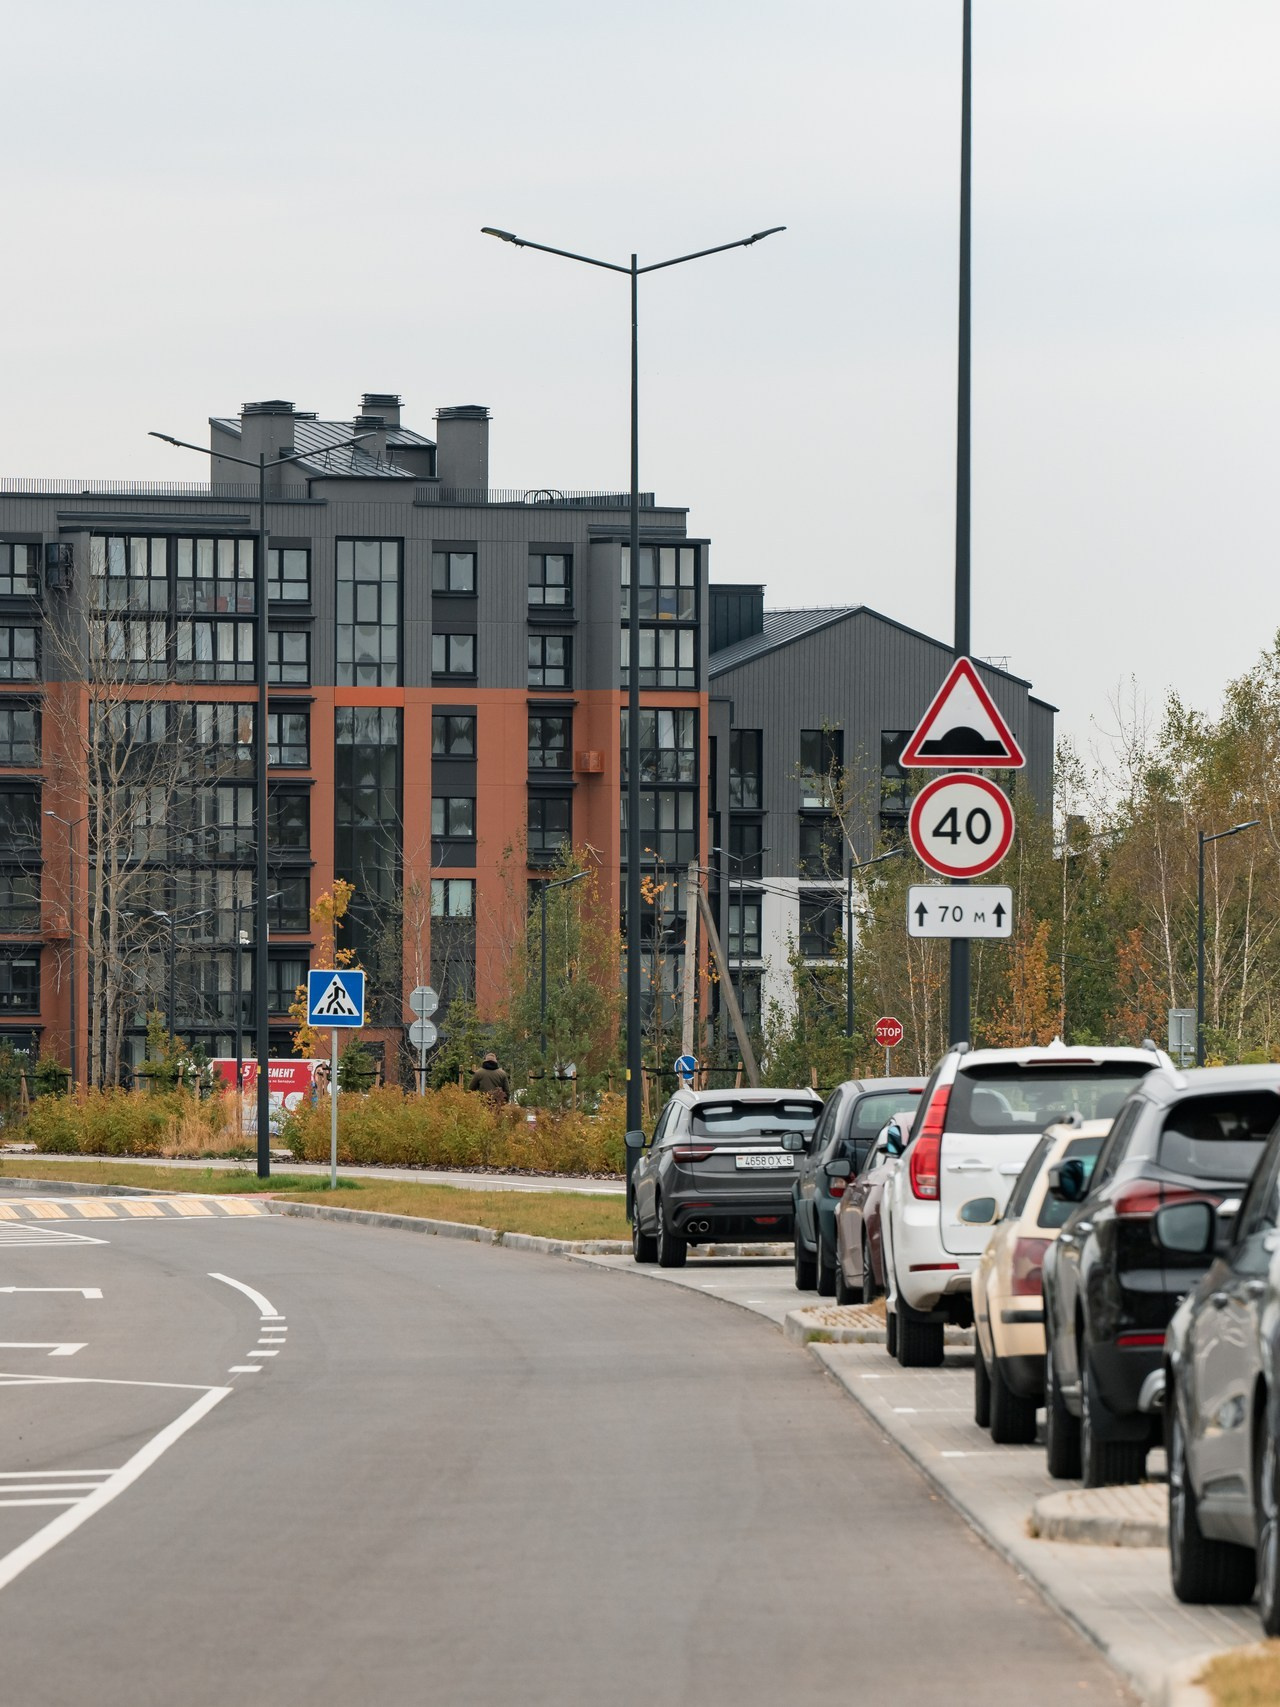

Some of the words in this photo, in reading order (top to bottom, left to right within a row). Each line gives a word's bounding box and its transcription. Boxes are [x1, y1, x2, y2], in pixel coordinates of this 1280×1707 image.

[932, 807, 991, 845] 40
[938, 905, 963, 922] 70
[876, 1027, 901, 1037] STOP
[242, 1065, 252, 1078] 5
[268, 1067, 295, 1078] ЕМЕНТ
